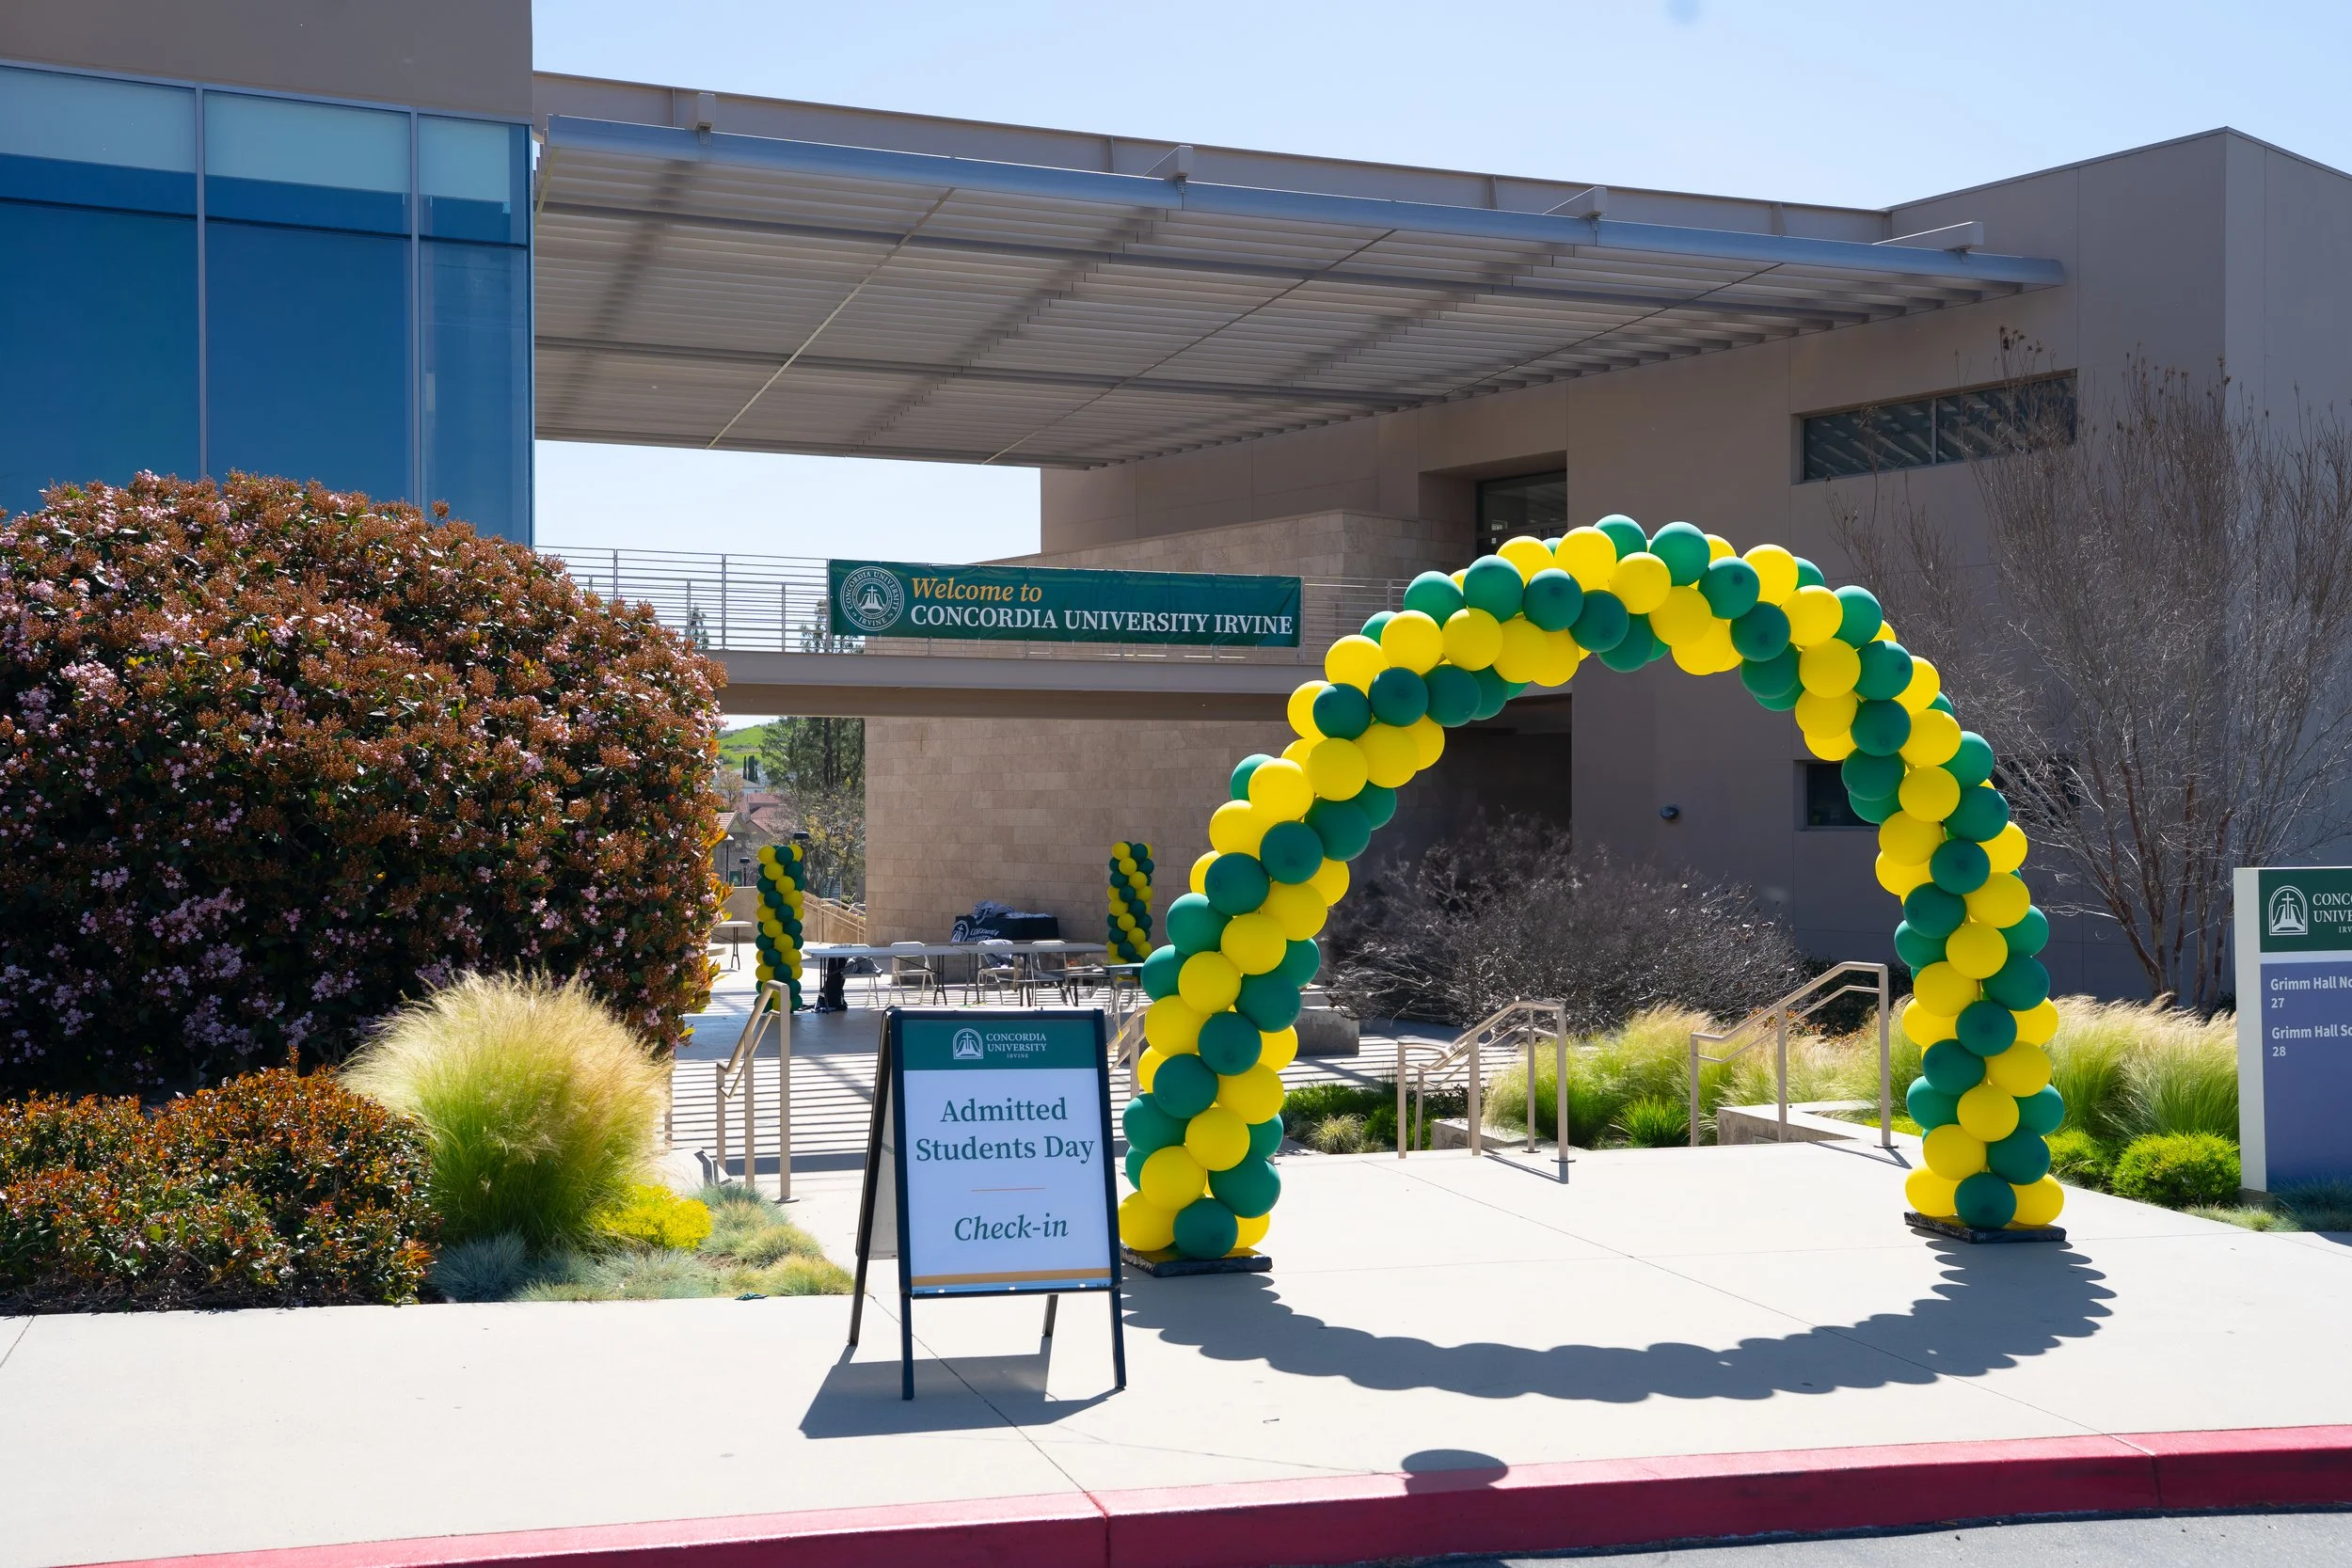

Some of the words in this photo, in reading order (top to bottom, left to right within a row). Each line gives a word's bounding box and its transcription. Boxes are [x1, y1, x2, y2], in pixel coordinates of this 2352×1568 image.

[912, 578, 1014, 601] Welcome
[1020, 583, 1042, 602] to
[911, 605, 1057, 629] CONCORDIA
[1064, 610, 1209, 633] UNIVERSITY
[1214, 614, 1293, 635] IRVINE
[2312, 893, 2352, 906] CONC
[2270, 977, 2311, 990] Grimm
[2313, 975, 2337, 990] Hall
[2271, 997, 2285, 1008] 27
[986, 1033, 1046, 1041] CONCORDIA
[2271, 1025, 2312, 1039] Grimm
[2314, 1023, 2339, 1037] Hall
[987, 1043, 1047, 1052] UNIVERSITY
[2272, 1046, 2286, 1057] 28
[940, 1097, 1068, 1122] Admitted
[916, 1136, 1036, 1162] Students
[1043, 1135, 1095, 1164] Day
[954, 1212, 1069, 1242] Check-in
